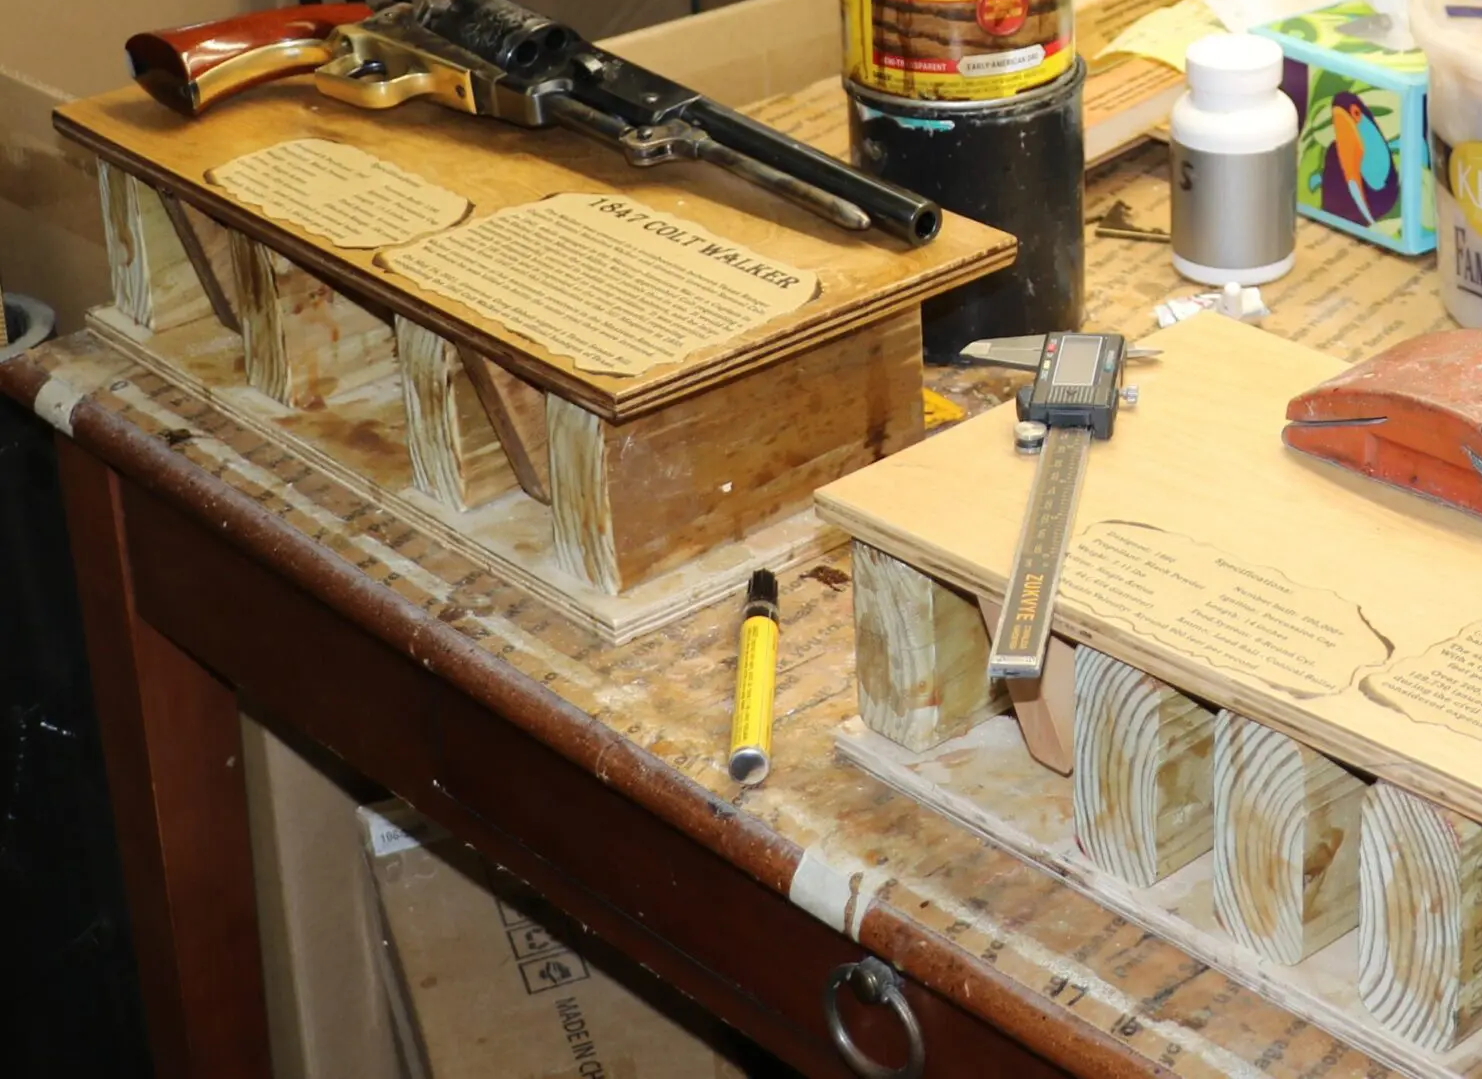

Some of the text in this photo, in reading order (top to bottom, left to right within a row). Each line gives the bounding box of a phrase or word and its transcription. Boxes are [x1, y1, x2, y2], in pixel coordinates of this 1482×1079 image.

[588, 196, 801, 291] 1847 COLT WALKER
[1015, 573, 1044, 621] ZUKVYE
[1210, 557, 1298, 595] Specifications:
[1201, 601, 1292, 640] Length: 14 inches
[1215, 594, 1339, 648] Ignition: Percussion Cap
[1230, 586, 1275, 605] Number
[1270, 603, 1301, 617] built:
[1447, 642, 1473, 655] The
[555, 996, 606, 1079] MADE IN CH
